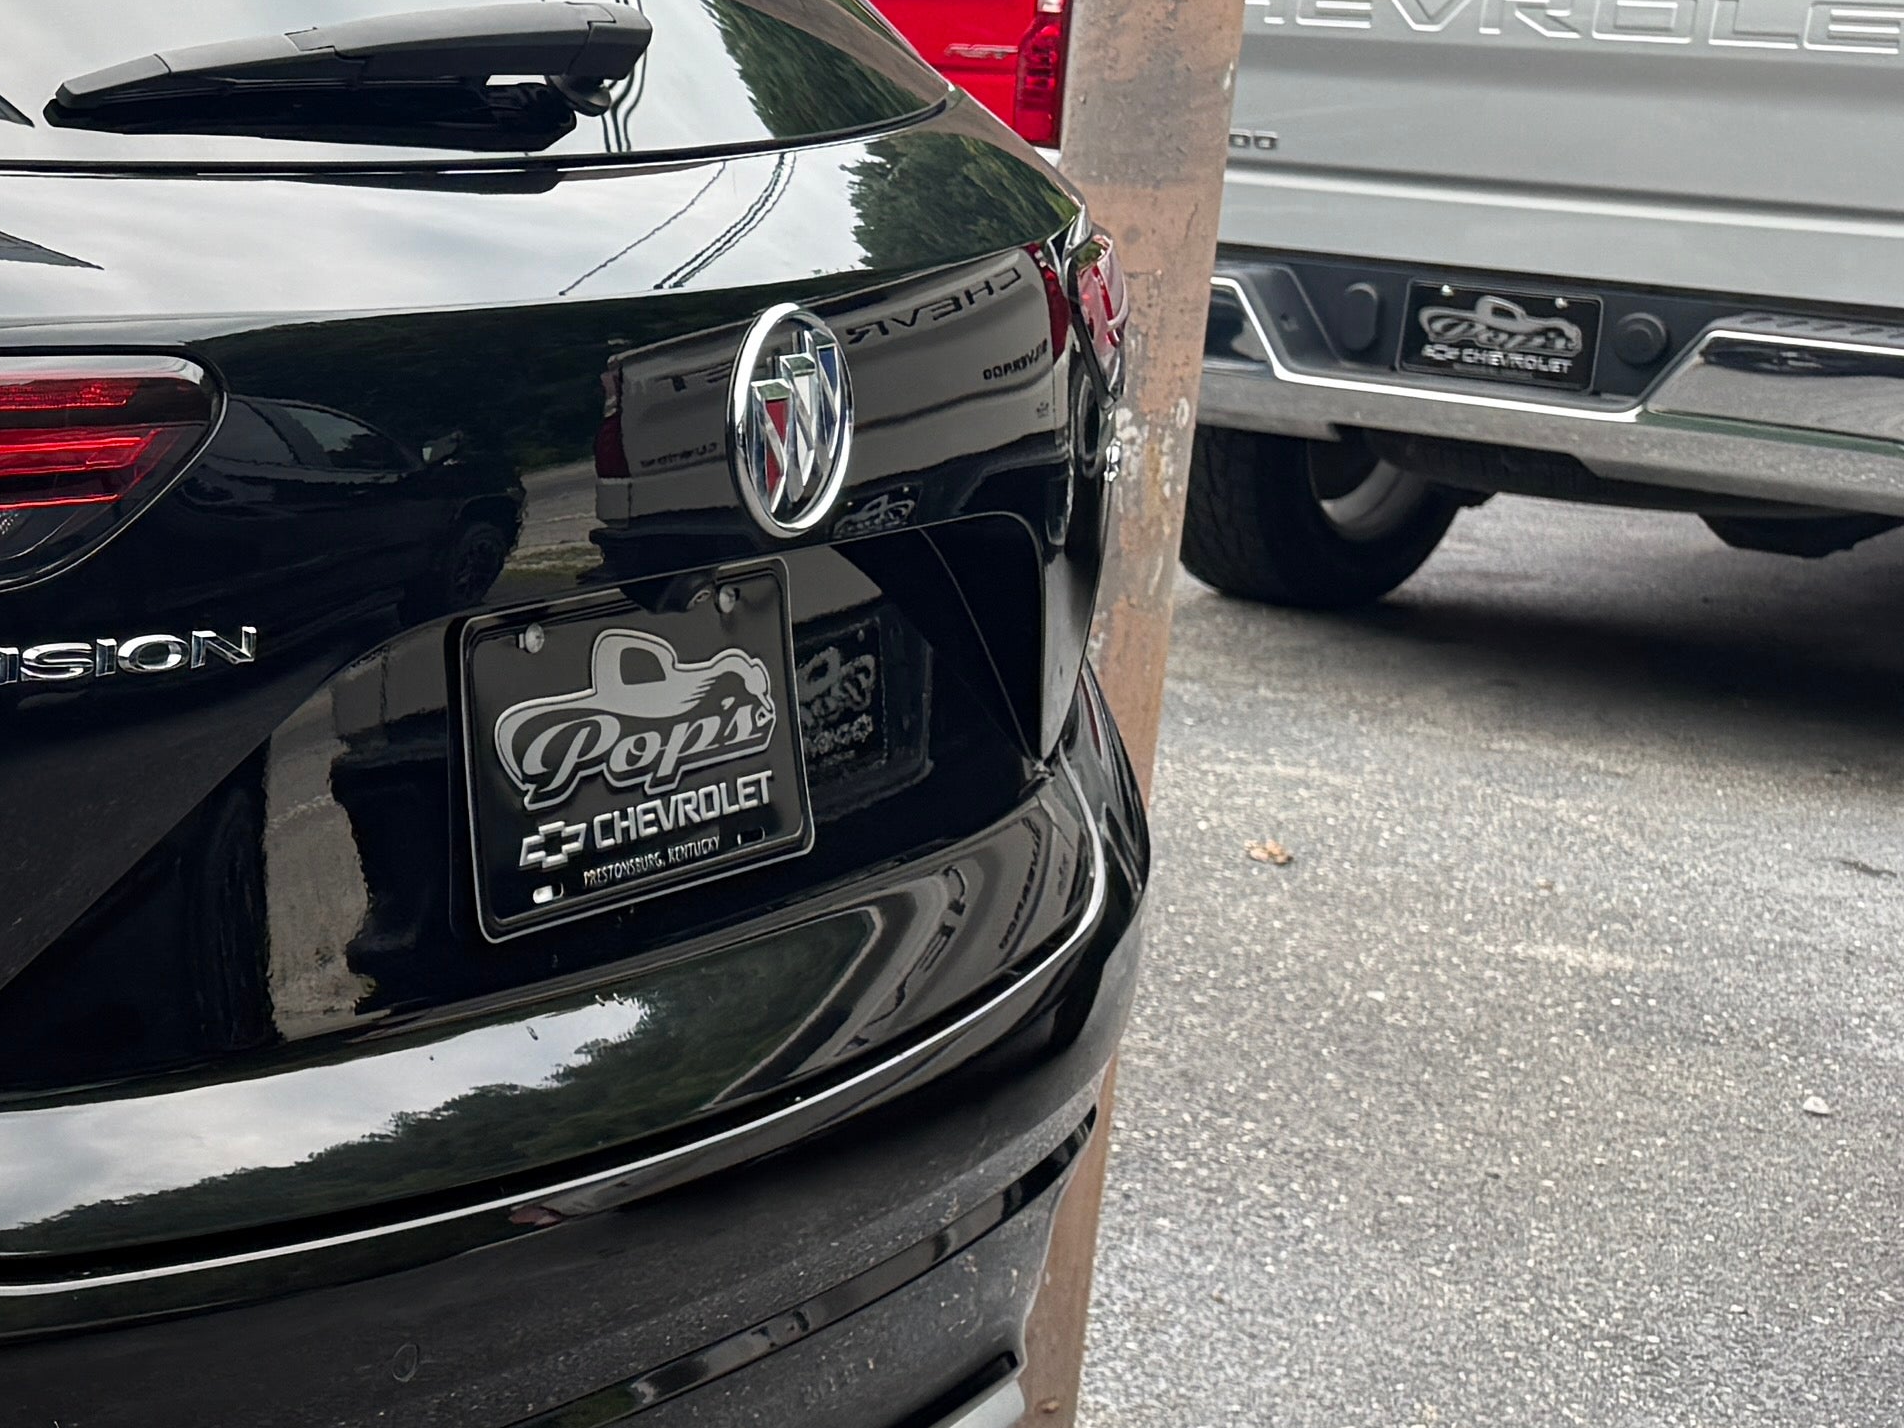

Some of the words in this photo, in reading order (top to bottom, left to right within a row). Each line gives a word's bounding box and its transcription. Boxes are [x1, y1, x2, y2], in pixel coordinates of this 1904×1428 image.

[1460, 347, 1574, 375] CHEVROLET
[522, 697, 766, 792] Pop's
[593, 770, 773, 850] CHEVROLET
[667, 835, 721, 864] KENTUCKY
